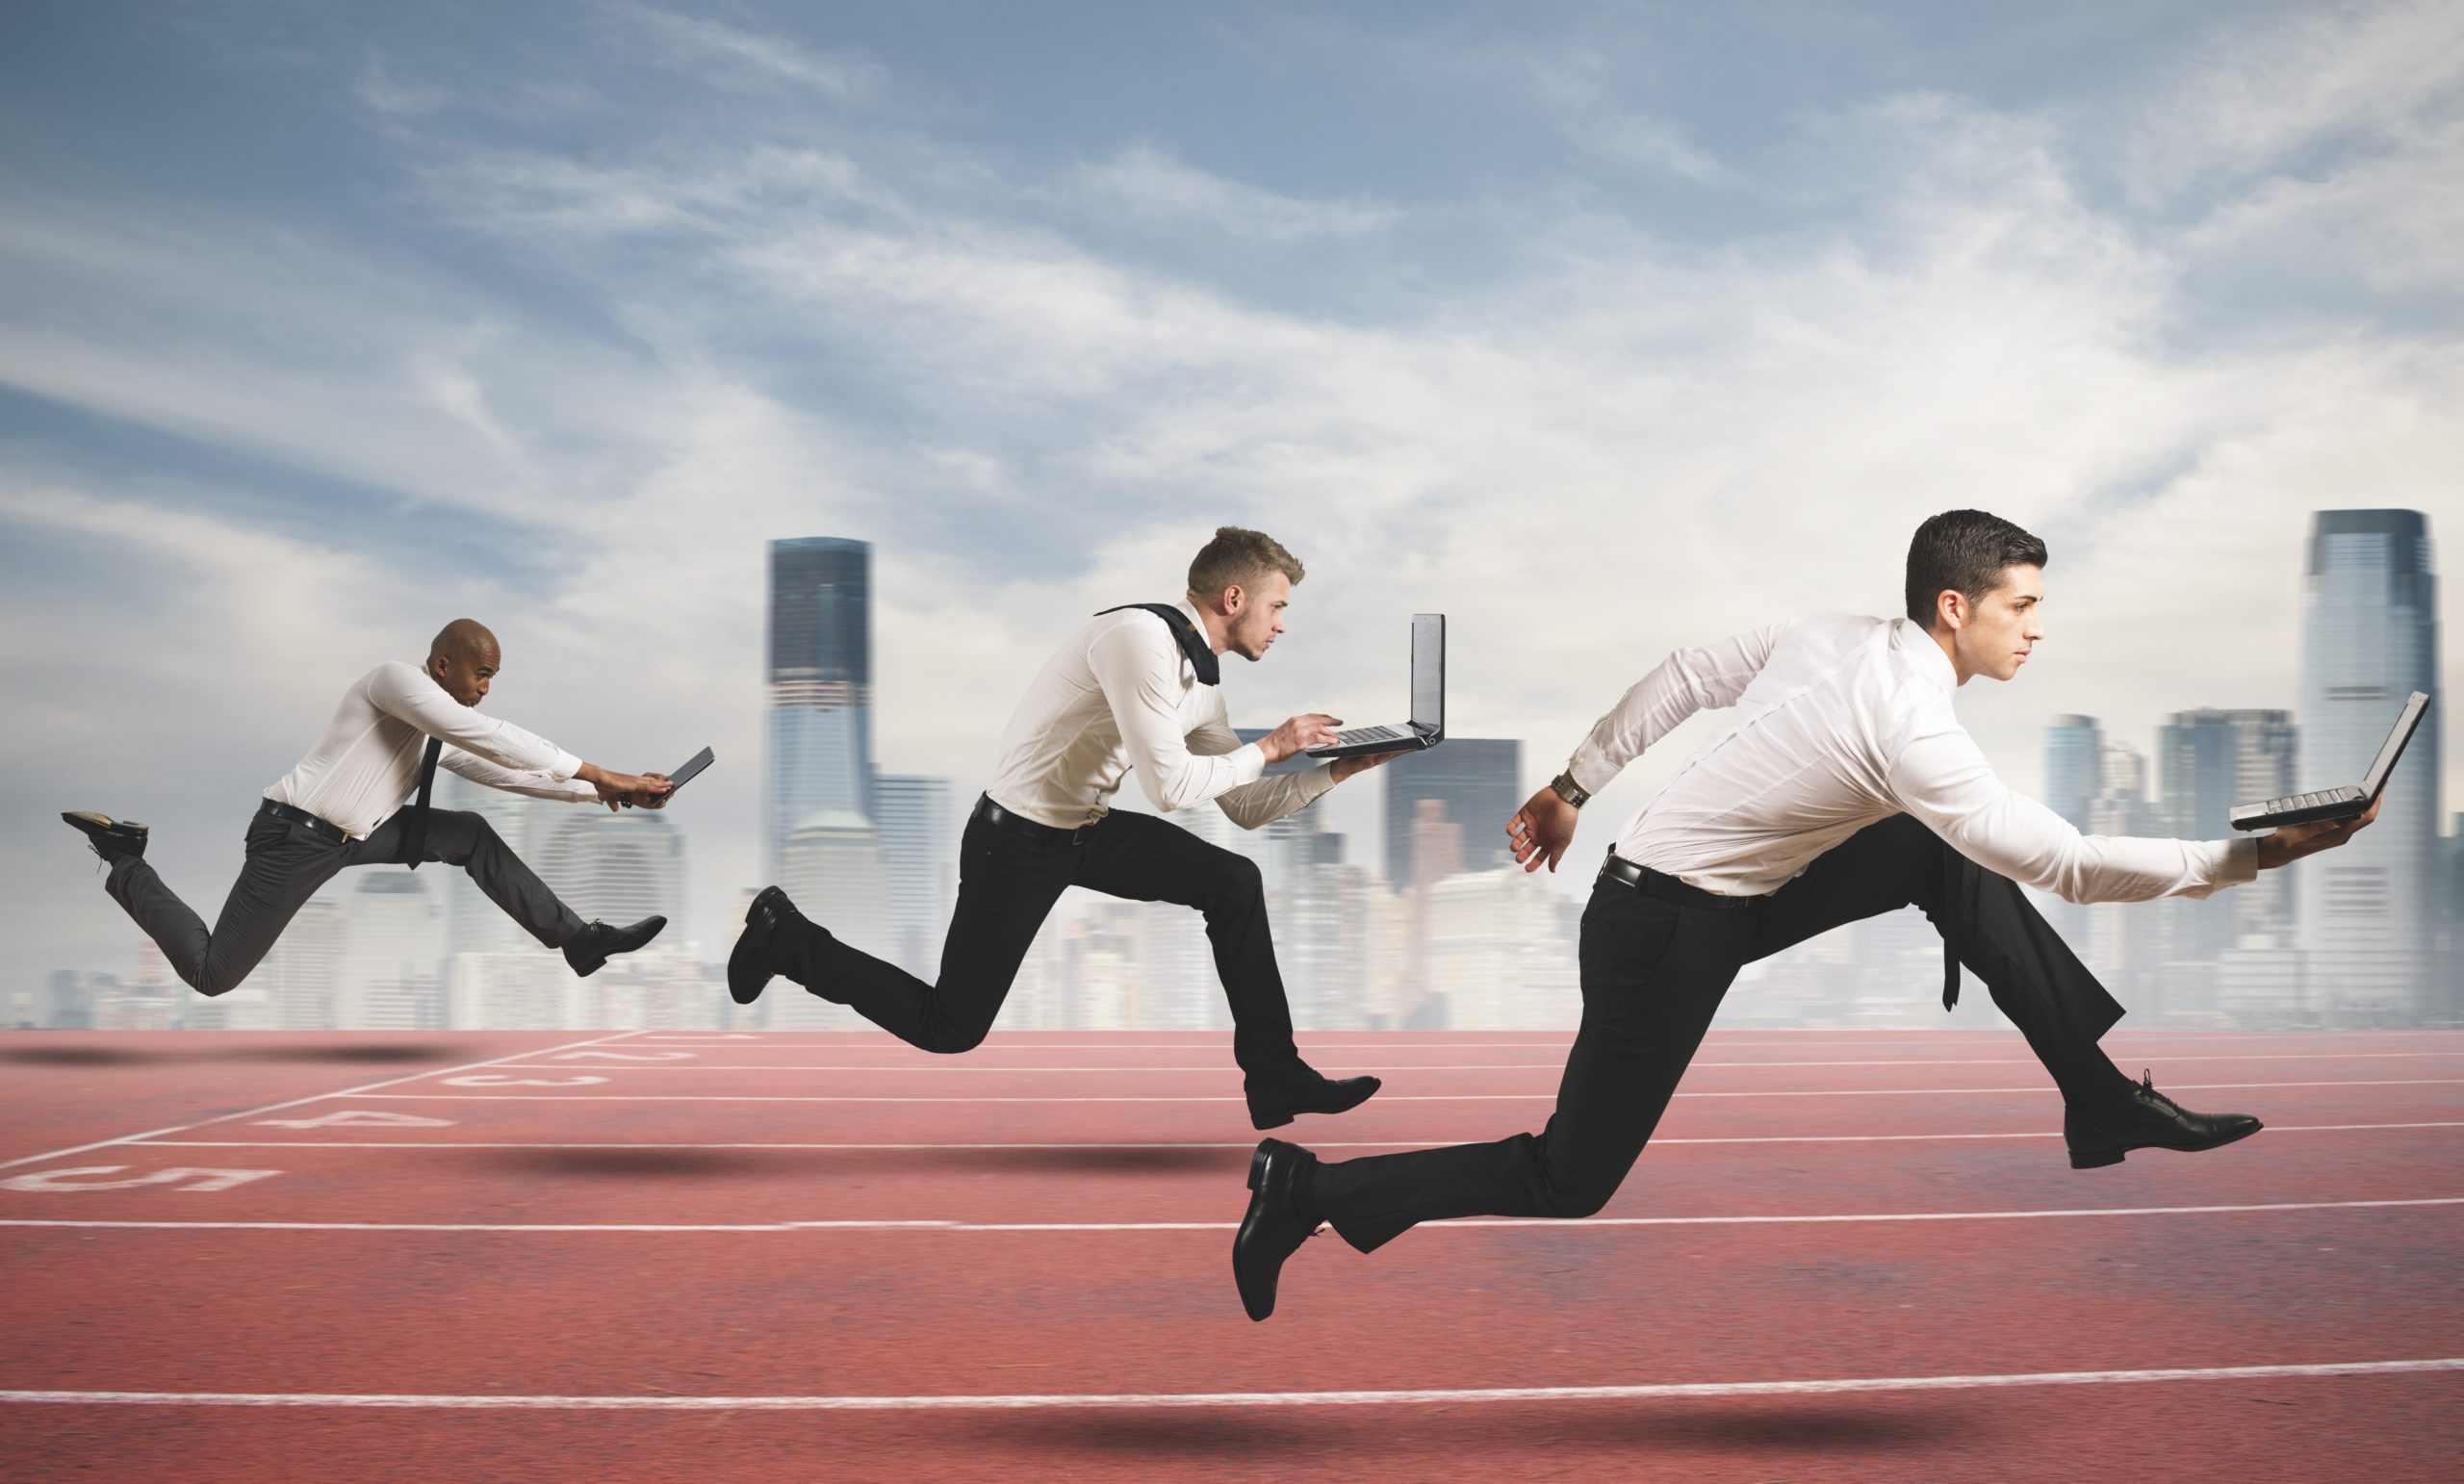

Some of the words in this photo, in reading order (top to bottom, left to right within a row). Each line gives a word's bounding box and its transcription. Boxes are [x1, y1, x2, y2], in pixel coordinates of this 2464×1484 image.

[549, 1051, 698, 1061] 2
[439, 1074, 610, 1087] 3
[249, 1110, 458, 1129] 4
[0, 1164, 285, 1192] 5
